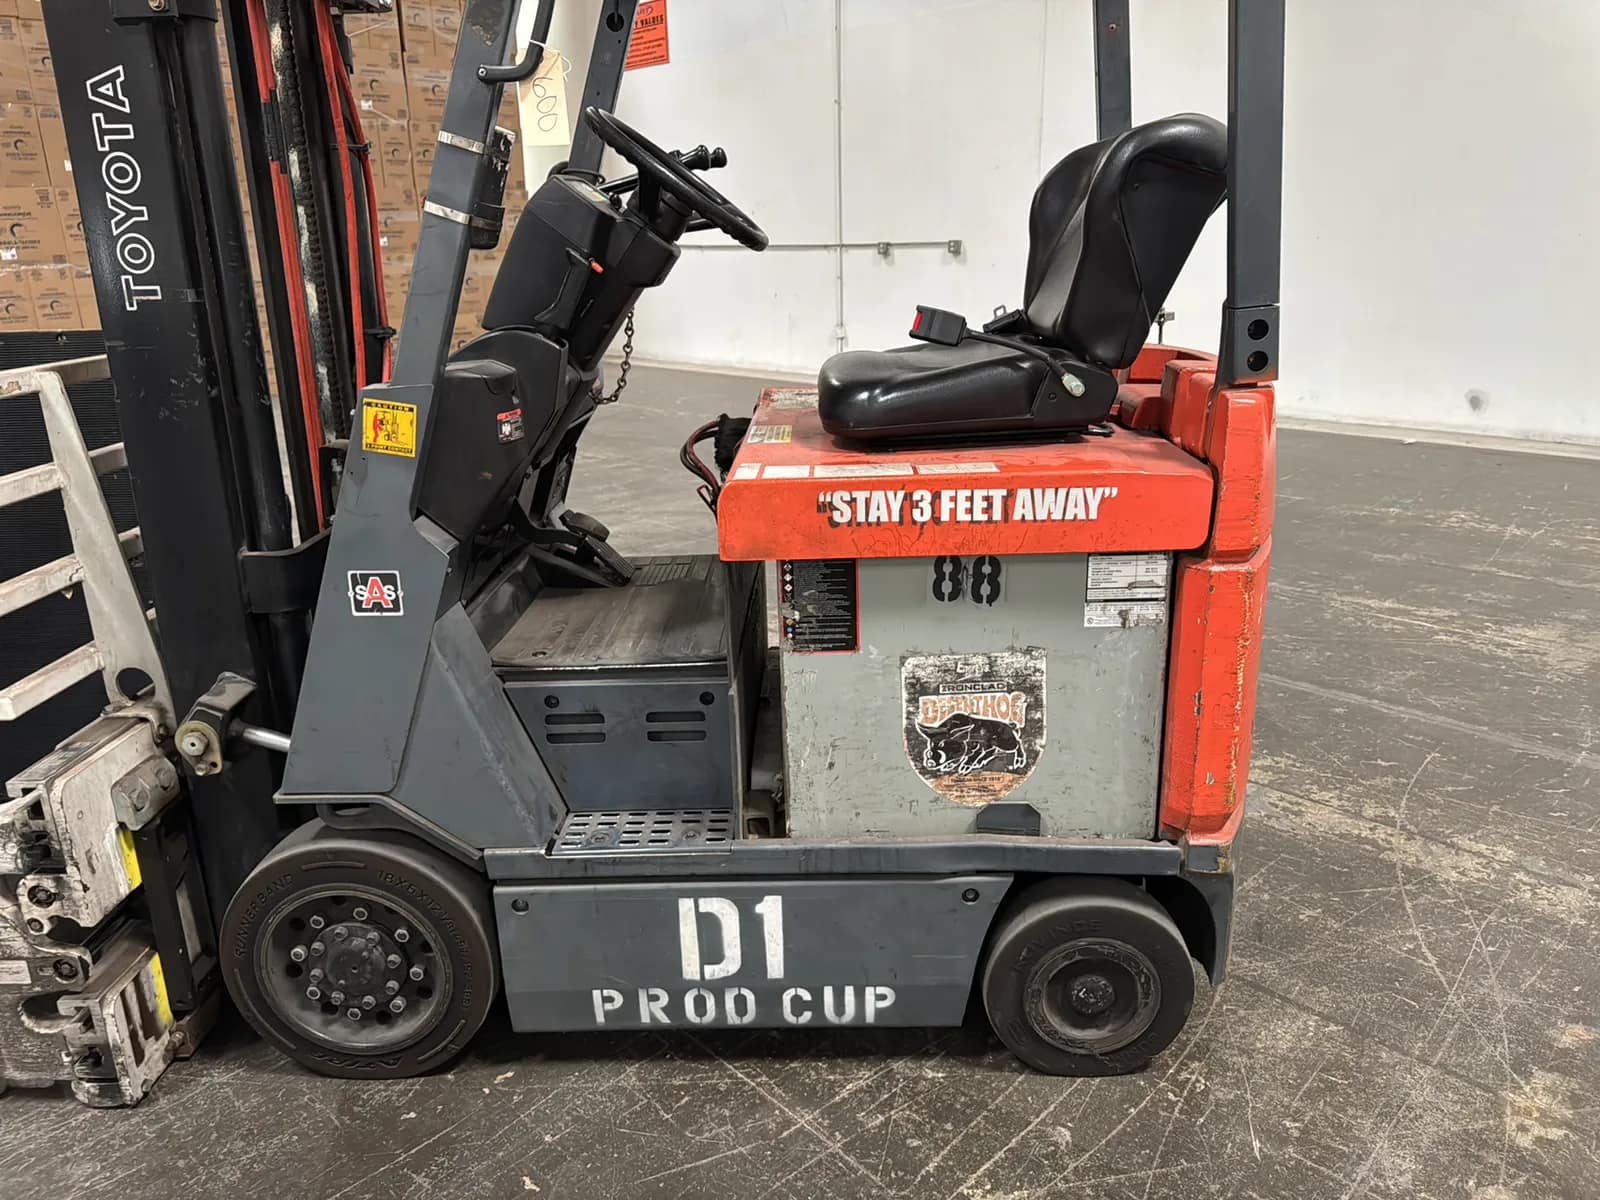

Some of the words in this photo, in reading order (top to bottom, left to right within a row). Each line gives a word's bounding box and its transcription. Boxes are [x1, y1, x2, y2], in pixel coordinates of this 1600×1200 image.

[86, 65, 162, 310] TOYOTA
[912, 489, 932, 522] 3
[940, 488, 1008, 521] FEET
[355, 576, 396, 609] SAS
[941, 682, 1006, 692] IRONCLAD
[233, 901, 258, 959] RUNNER
[257, 873, 293, 904] BAND
[678, 895, 784, 980] D1
[592, 987, 756, 1026] PROD
[782, 985, 896, 1024] CUP
